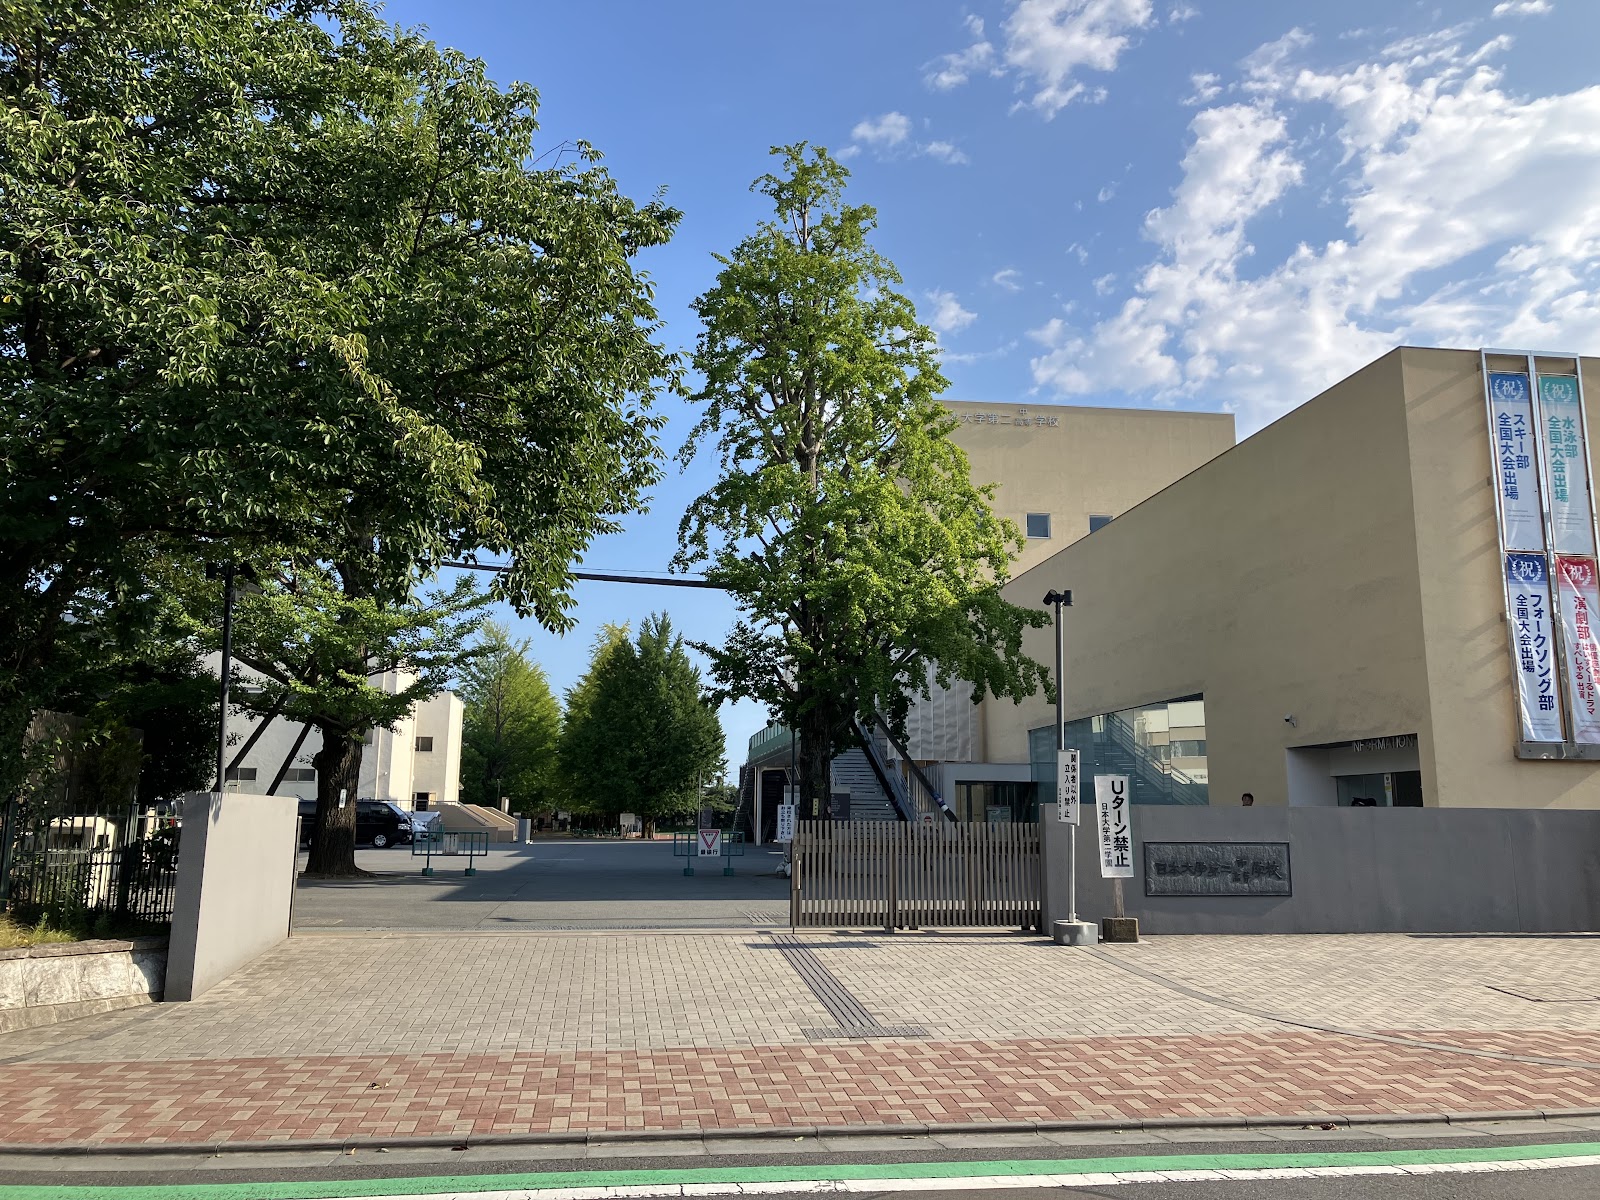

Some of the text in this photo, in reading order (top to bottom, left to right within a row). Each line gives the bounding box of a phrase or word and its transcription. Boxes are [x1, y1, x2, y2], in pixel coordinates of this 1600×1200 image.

[1501, 380, 1517, 396] 祝
[1551, 384, 1566, 399] 祝
[1498, 412, 1519, 501] 全国大会出場
[1513, 413, 1530, 470] スキー部
[1548, 415, 1569, 503] 全国大会出場
[1562, 416, 1578, 459] 水泳部
[1519, 561, 1534, 578] 祝
[1568, 565, 1585, 581] 祝
[1515, 594, 1535, 673] 全国大会出場
[1574, 596, 1591, 640] 演劇部
[1530, 594, 1555, 711] フォークソング部
[1101, 802, 1113, 868] 日本大学第二学園
[1111, 780, 1130, 868] Uターン禁止
